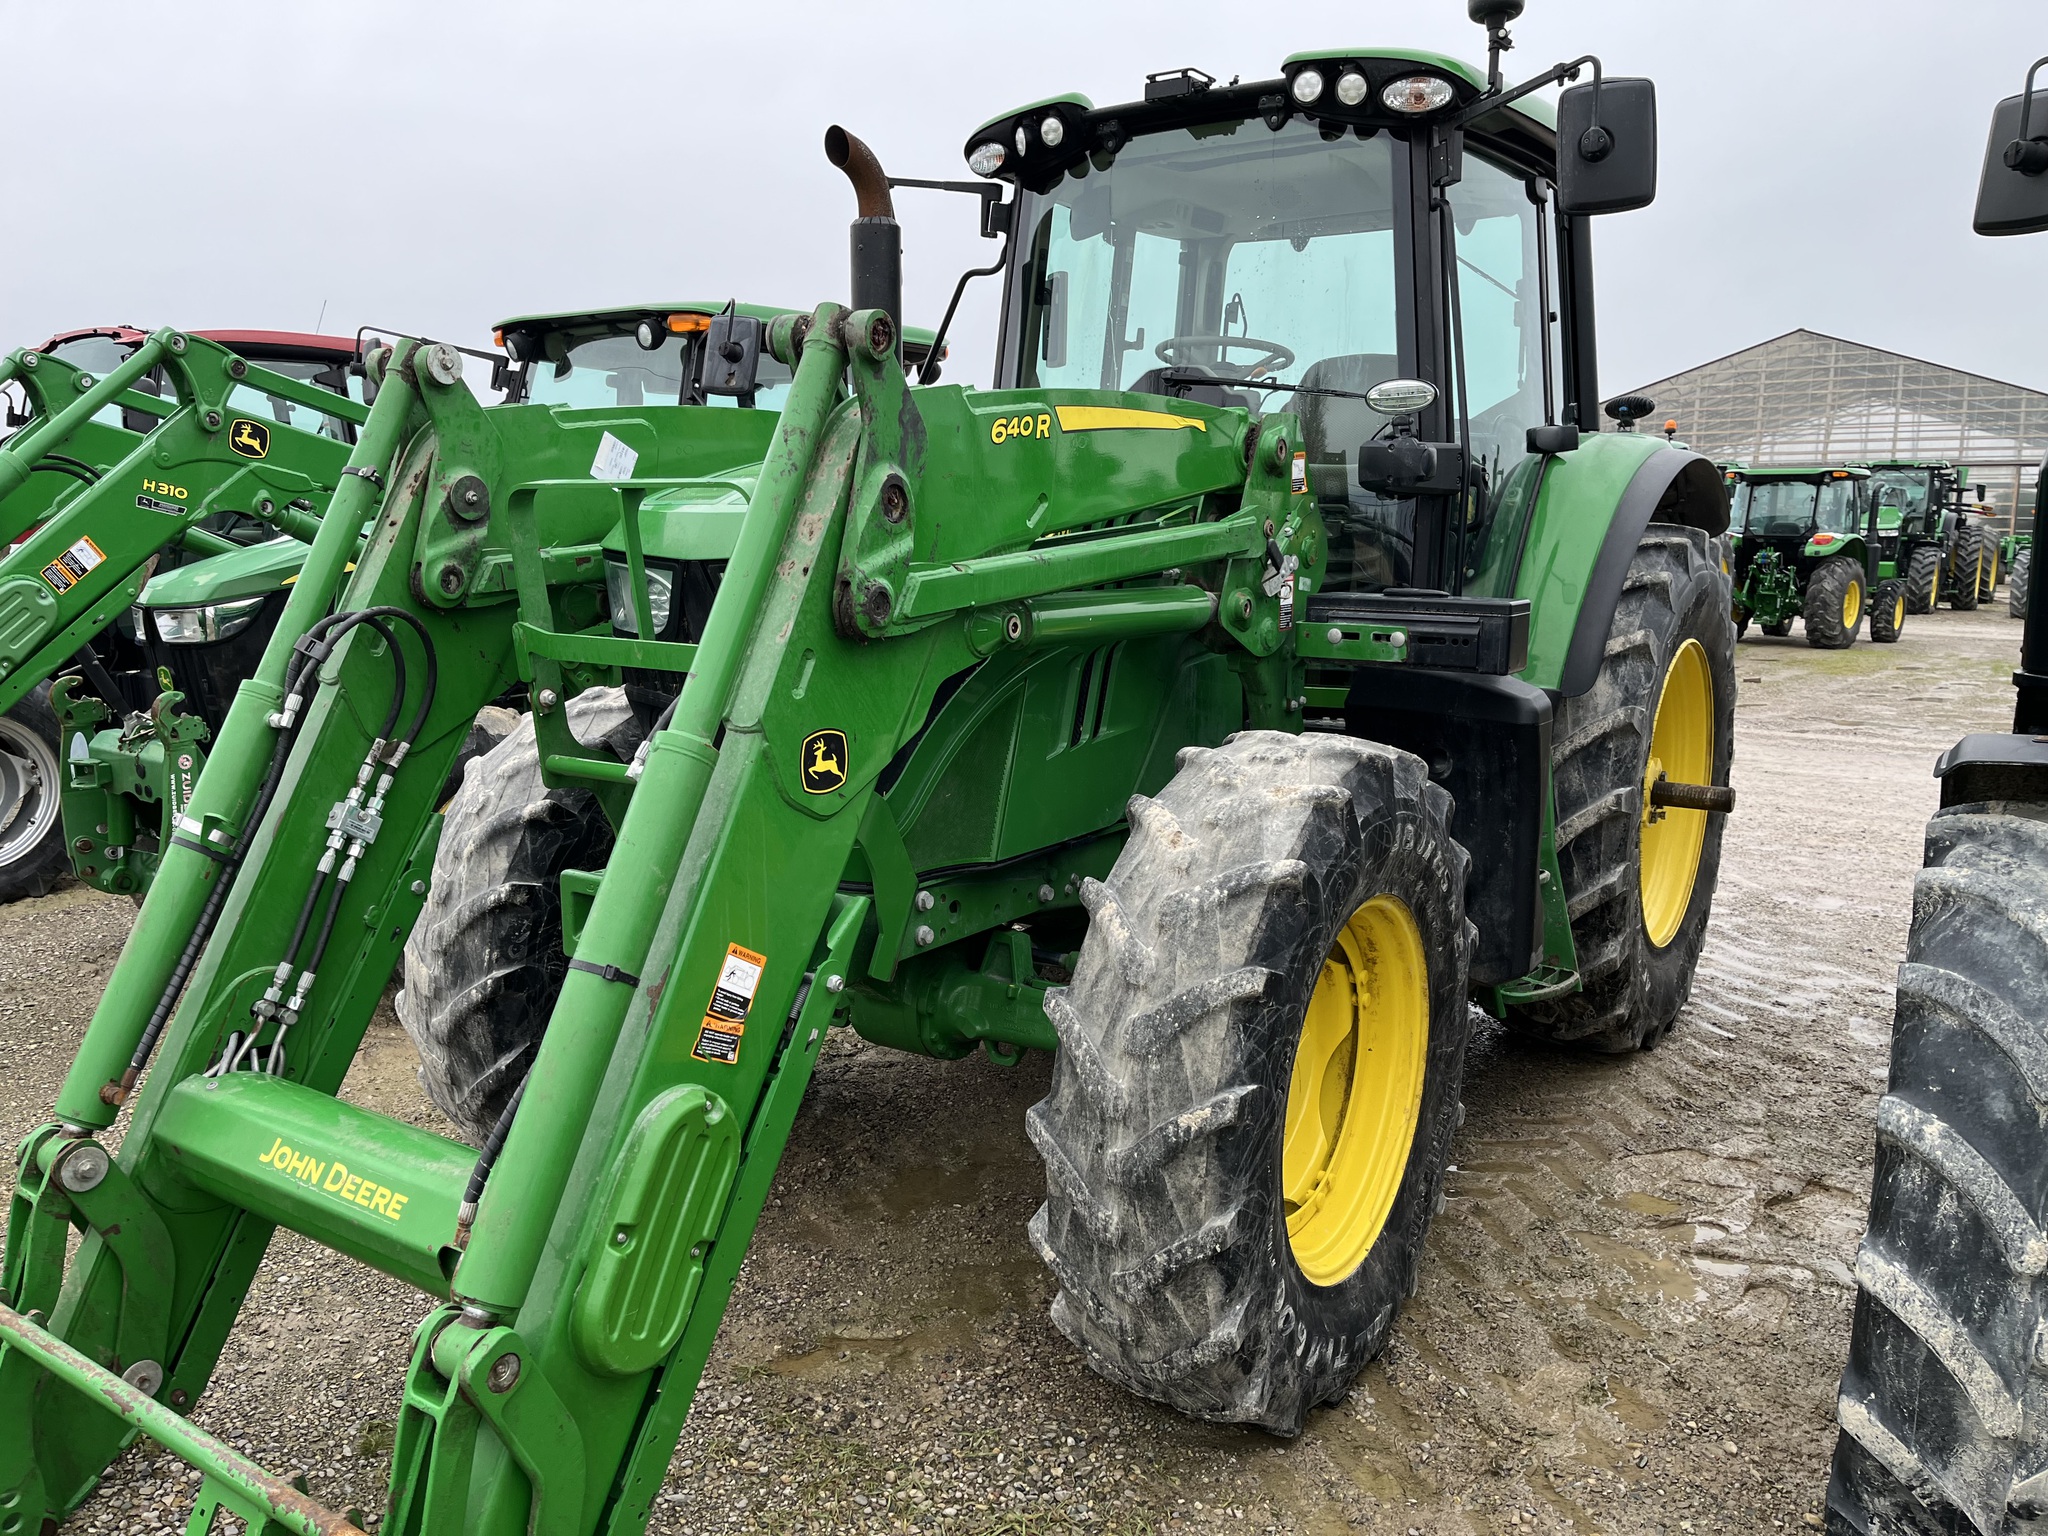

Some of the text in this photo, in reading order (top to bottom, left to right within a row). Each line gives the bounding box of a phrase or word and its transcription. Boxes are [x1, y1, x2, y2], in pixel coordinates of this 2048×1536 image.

[991, 412, 1051, 445] 640R
[738, 948, 762, 965] WARNING
[258, 1137, 409, 1221] JOHN DEERE
